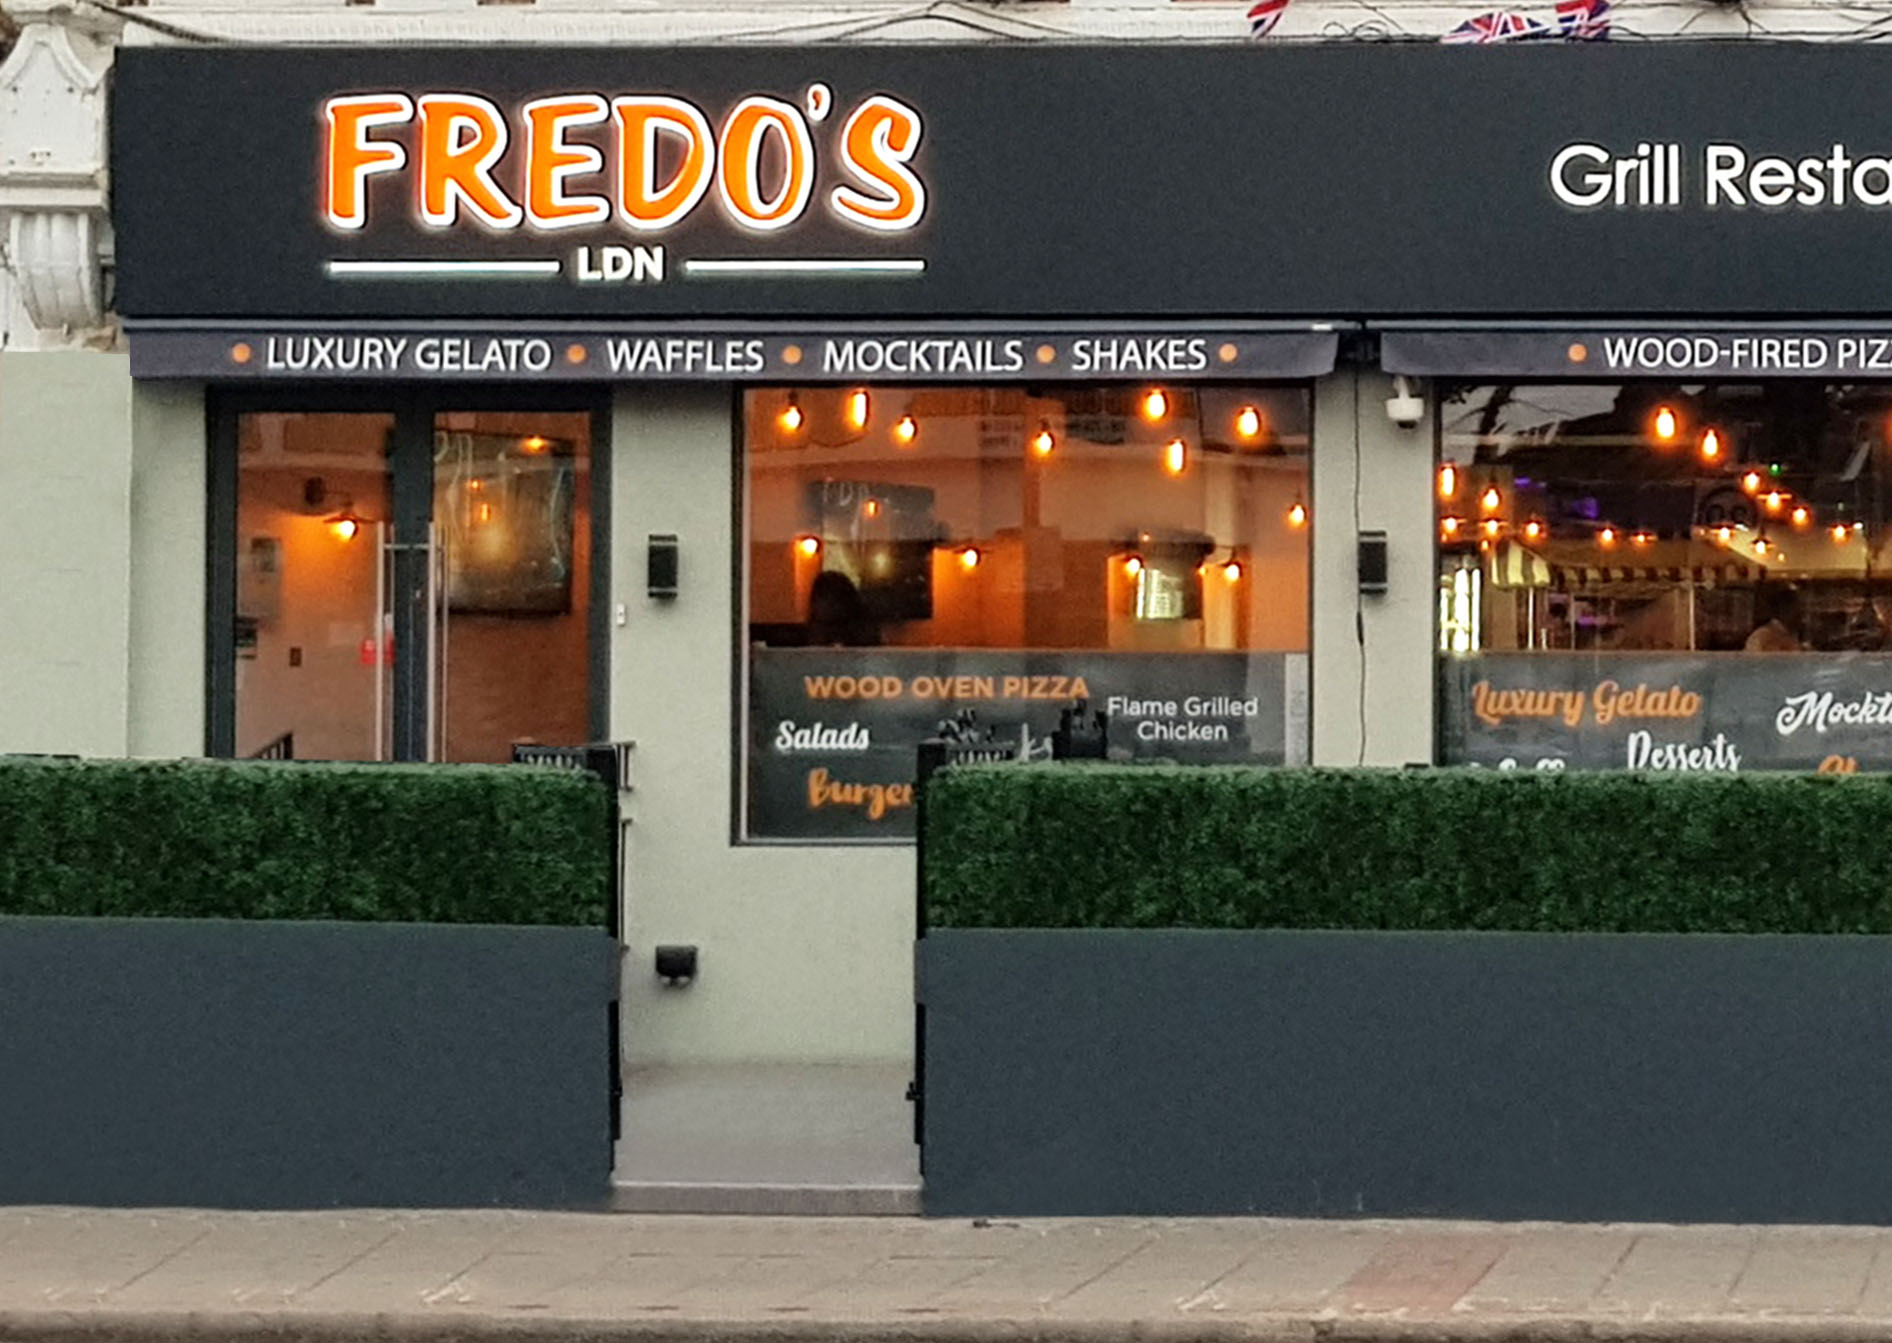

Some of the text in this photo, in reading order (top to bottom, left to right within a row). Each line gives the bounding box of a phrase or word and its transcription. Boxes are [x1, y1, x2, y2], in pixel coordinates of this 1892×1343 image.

[323, 83, 926, 233] FREDO'S
[1550, 143, 1680, 206] Grill
[577, 246, 664, 282] LDN
[266, 338, 1207, 372] LUXURY GELATO WAFFLES MOCKTAILS SHAKES
[1603, 337, 1827, 369] WOOD-FIRED
[804, 675, 1090, 699] WOOD OVEN PIZZA
[1473, 680, 1702, 727] Luxury Gelato
[1106, 695, 1259, 719] Flame Grilled
[774, 720, 871, 753] Salads
[1137, 720, 1229, 742] Chicken
[1626, 729, 1742, 772] Desserts
